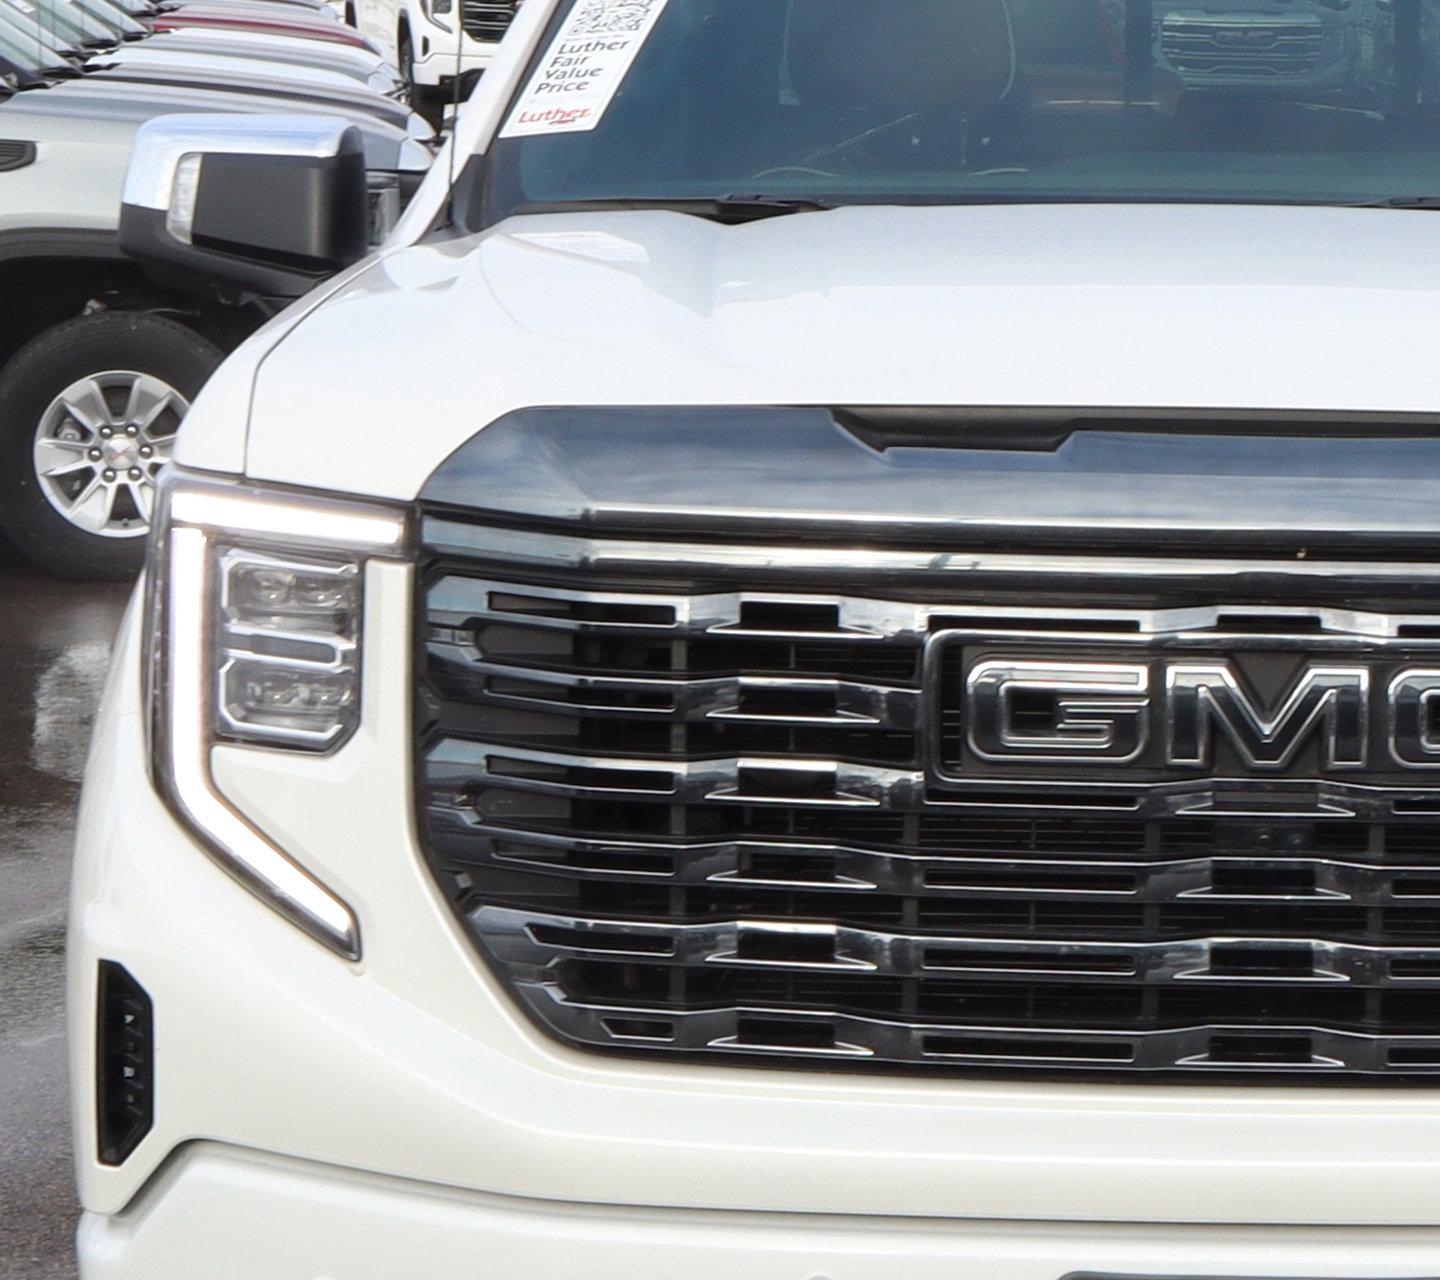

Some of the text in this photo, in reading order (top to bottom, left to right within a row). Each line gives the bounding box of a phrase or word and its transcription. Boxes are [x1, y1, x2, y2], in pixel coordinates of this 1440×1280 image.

[557, 39, 630, 55] Luther
[549, 54, 590, 68] Fair
[545, 66, 603, 81] Value
[534, 80, 589, 95] Price
[517, 107, 591, 124] Luther
